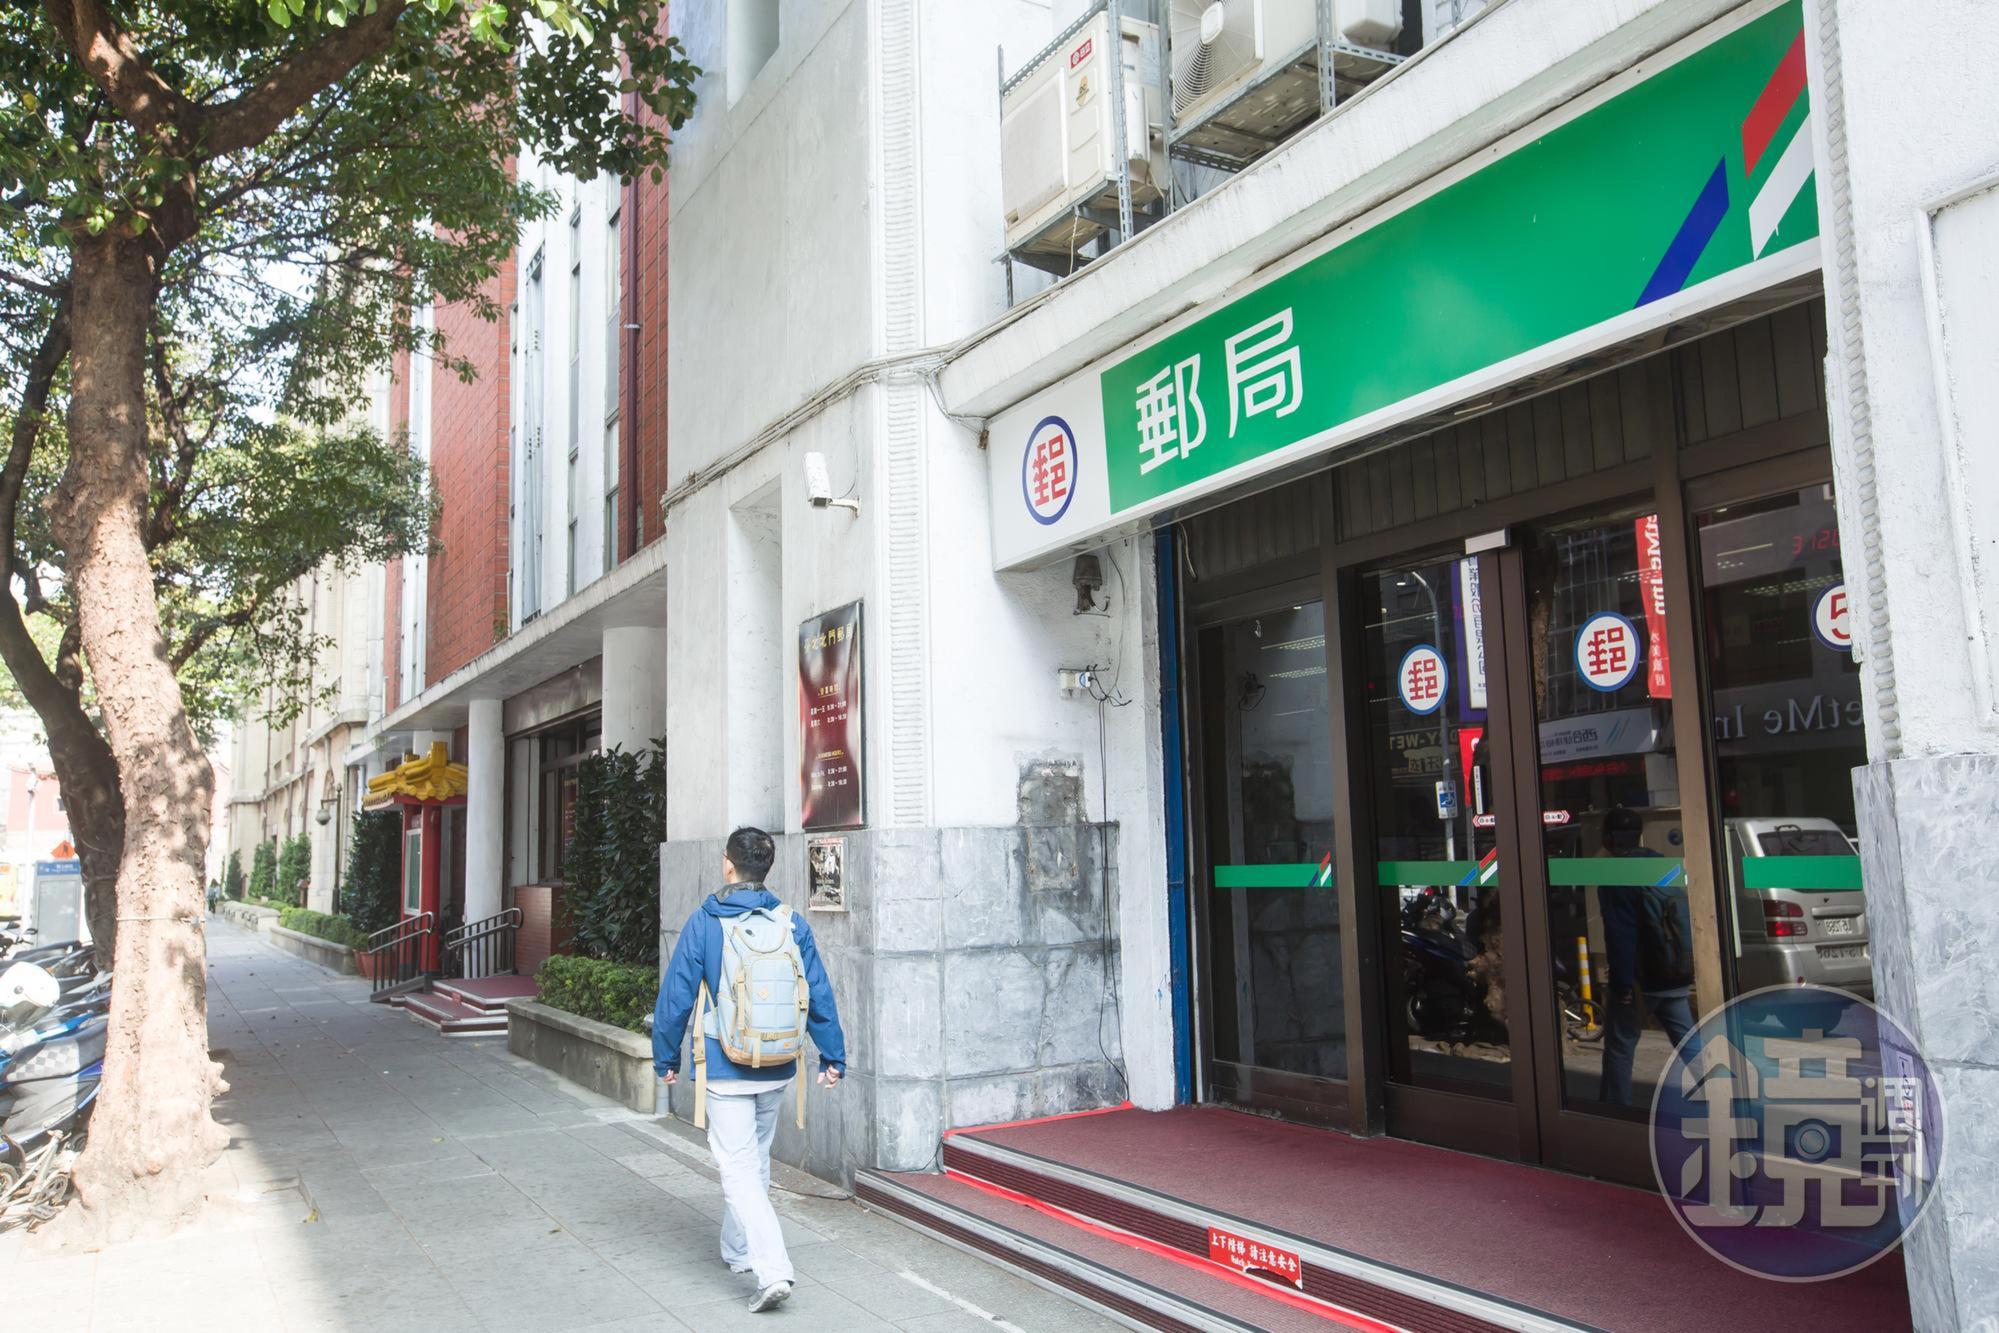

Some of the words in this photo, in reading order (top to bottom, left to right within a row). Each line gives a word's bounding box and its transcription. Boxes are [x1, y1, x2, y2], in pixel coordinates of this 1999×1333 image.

[1135, 306, 1304, 476] 郵局
[1032, 433, 1067, 507] 郵
[1830, 592, 1850, 640] 5
[1588, 626, 1627, 676] 郵
[1408, 658, 1438, 701] 郵
